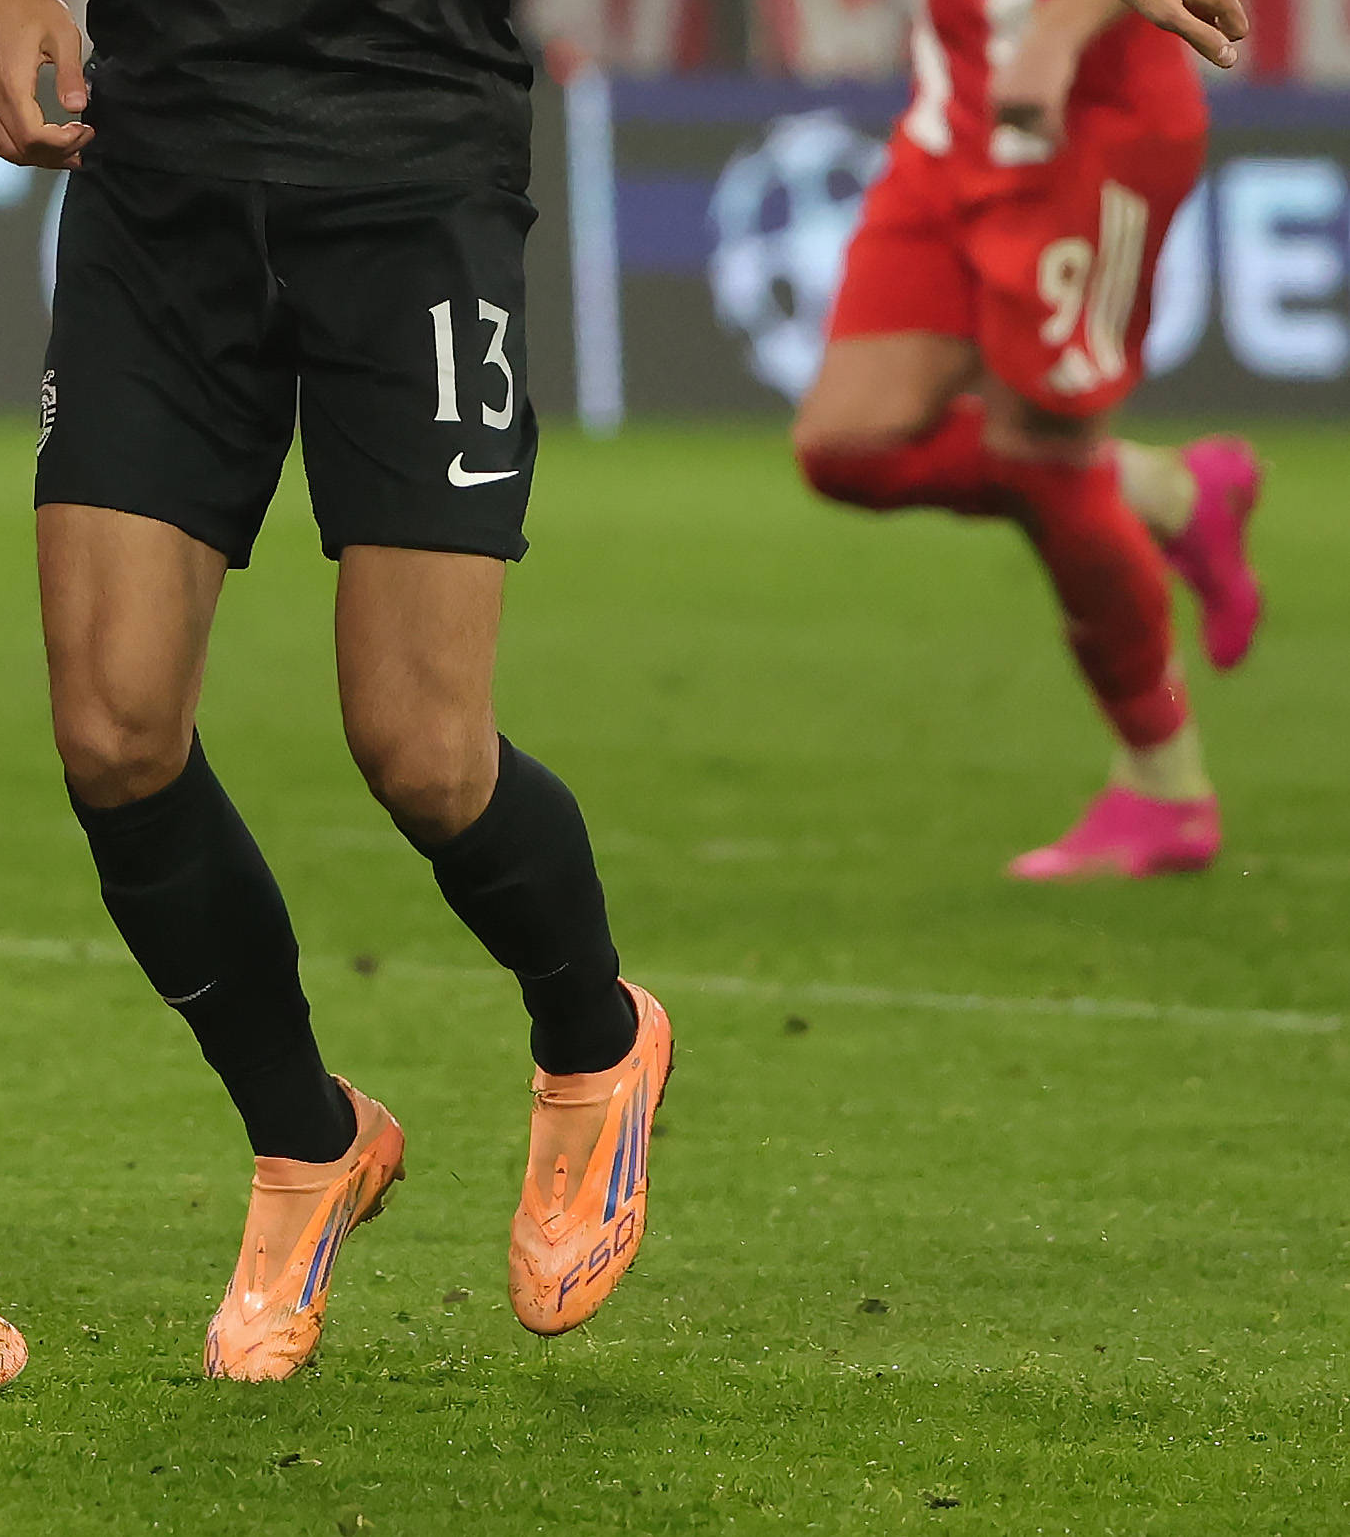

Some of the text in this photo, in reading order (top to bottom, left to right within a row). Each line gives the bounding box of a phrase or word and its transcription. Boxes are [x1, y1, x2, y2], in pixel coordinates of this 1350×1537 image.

[1036, 236, 1097, 346] 9
[428, 298, 514, 430] 13
[557, 1208, 636, 1314] F50
